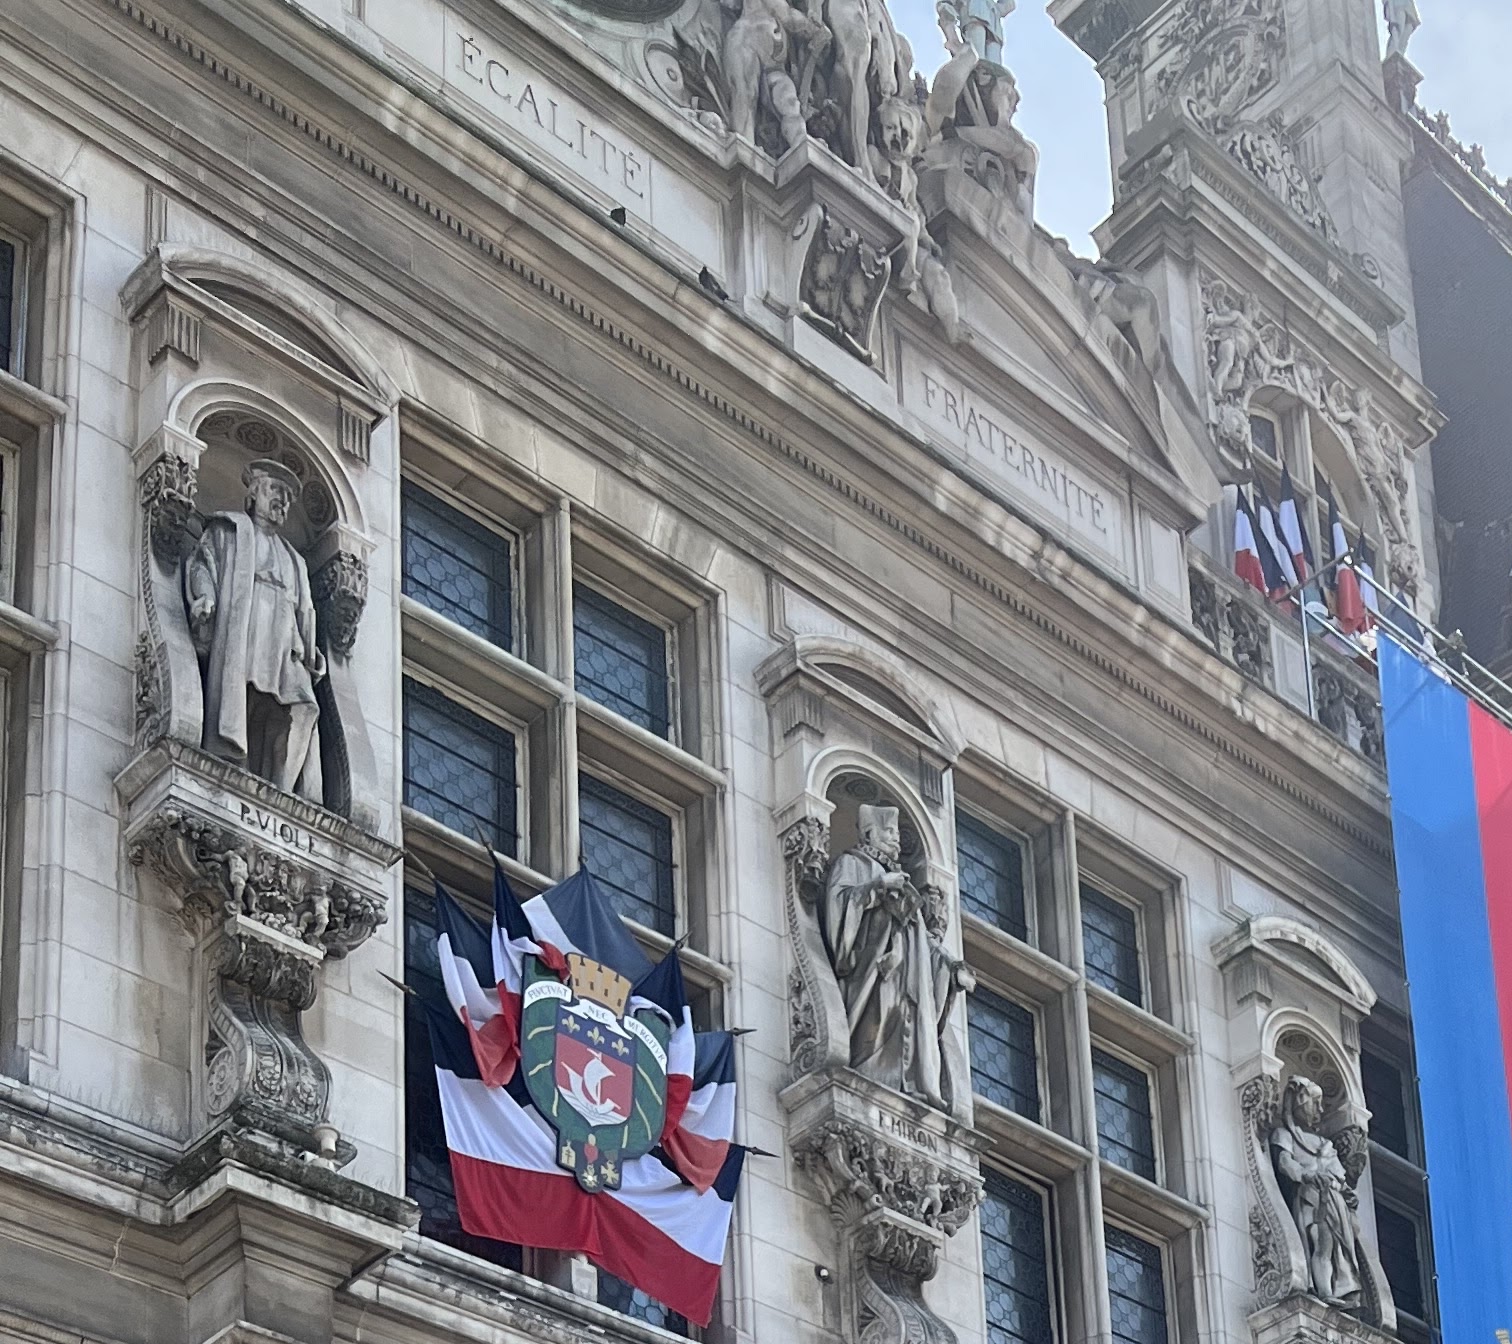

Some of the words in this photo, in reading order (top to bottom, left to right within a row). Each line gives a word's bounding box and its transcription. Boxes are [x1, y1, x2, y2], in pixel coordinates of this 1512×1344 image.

[921, 371, 1106, 535] FRATERNITÉ
[256, 809, 320, 858] VIOLE
[891, 1116, 938, 1153] MIRON
